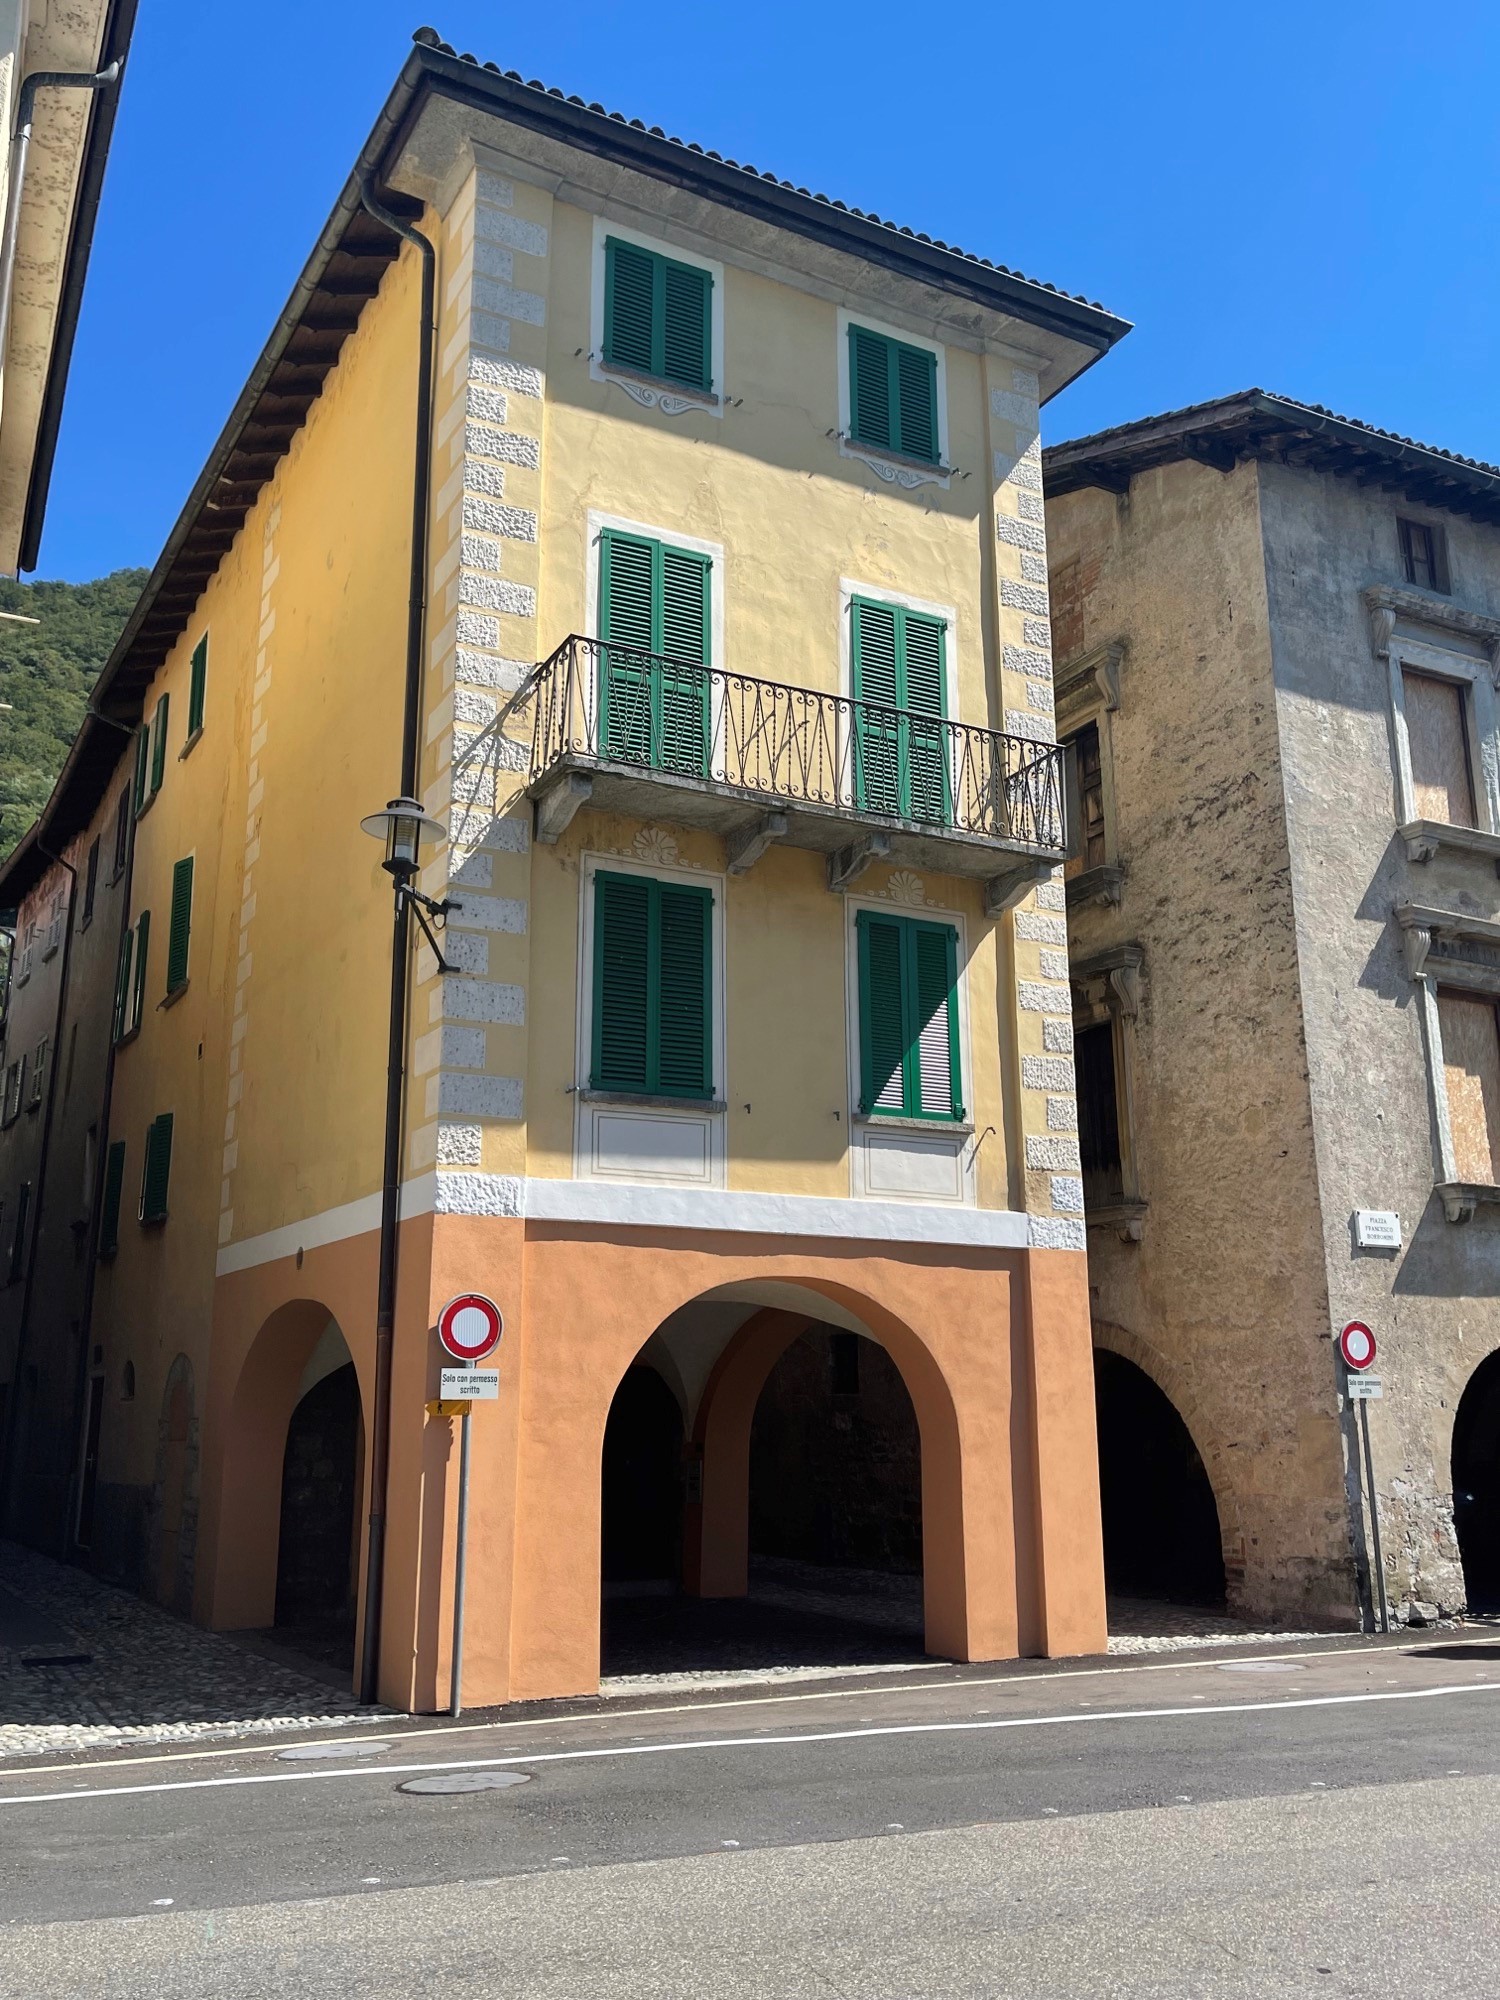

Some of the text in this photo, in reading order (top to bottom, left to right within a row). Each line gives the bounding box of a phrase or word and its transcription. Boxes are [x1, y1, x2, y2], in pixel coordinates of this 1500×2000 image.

[1365, 1225, 1394, 1233] FRANCESCO
[442, 1373, 498, 1384] Solo con permesso
[459, 1386, 481, 1394] scritto
